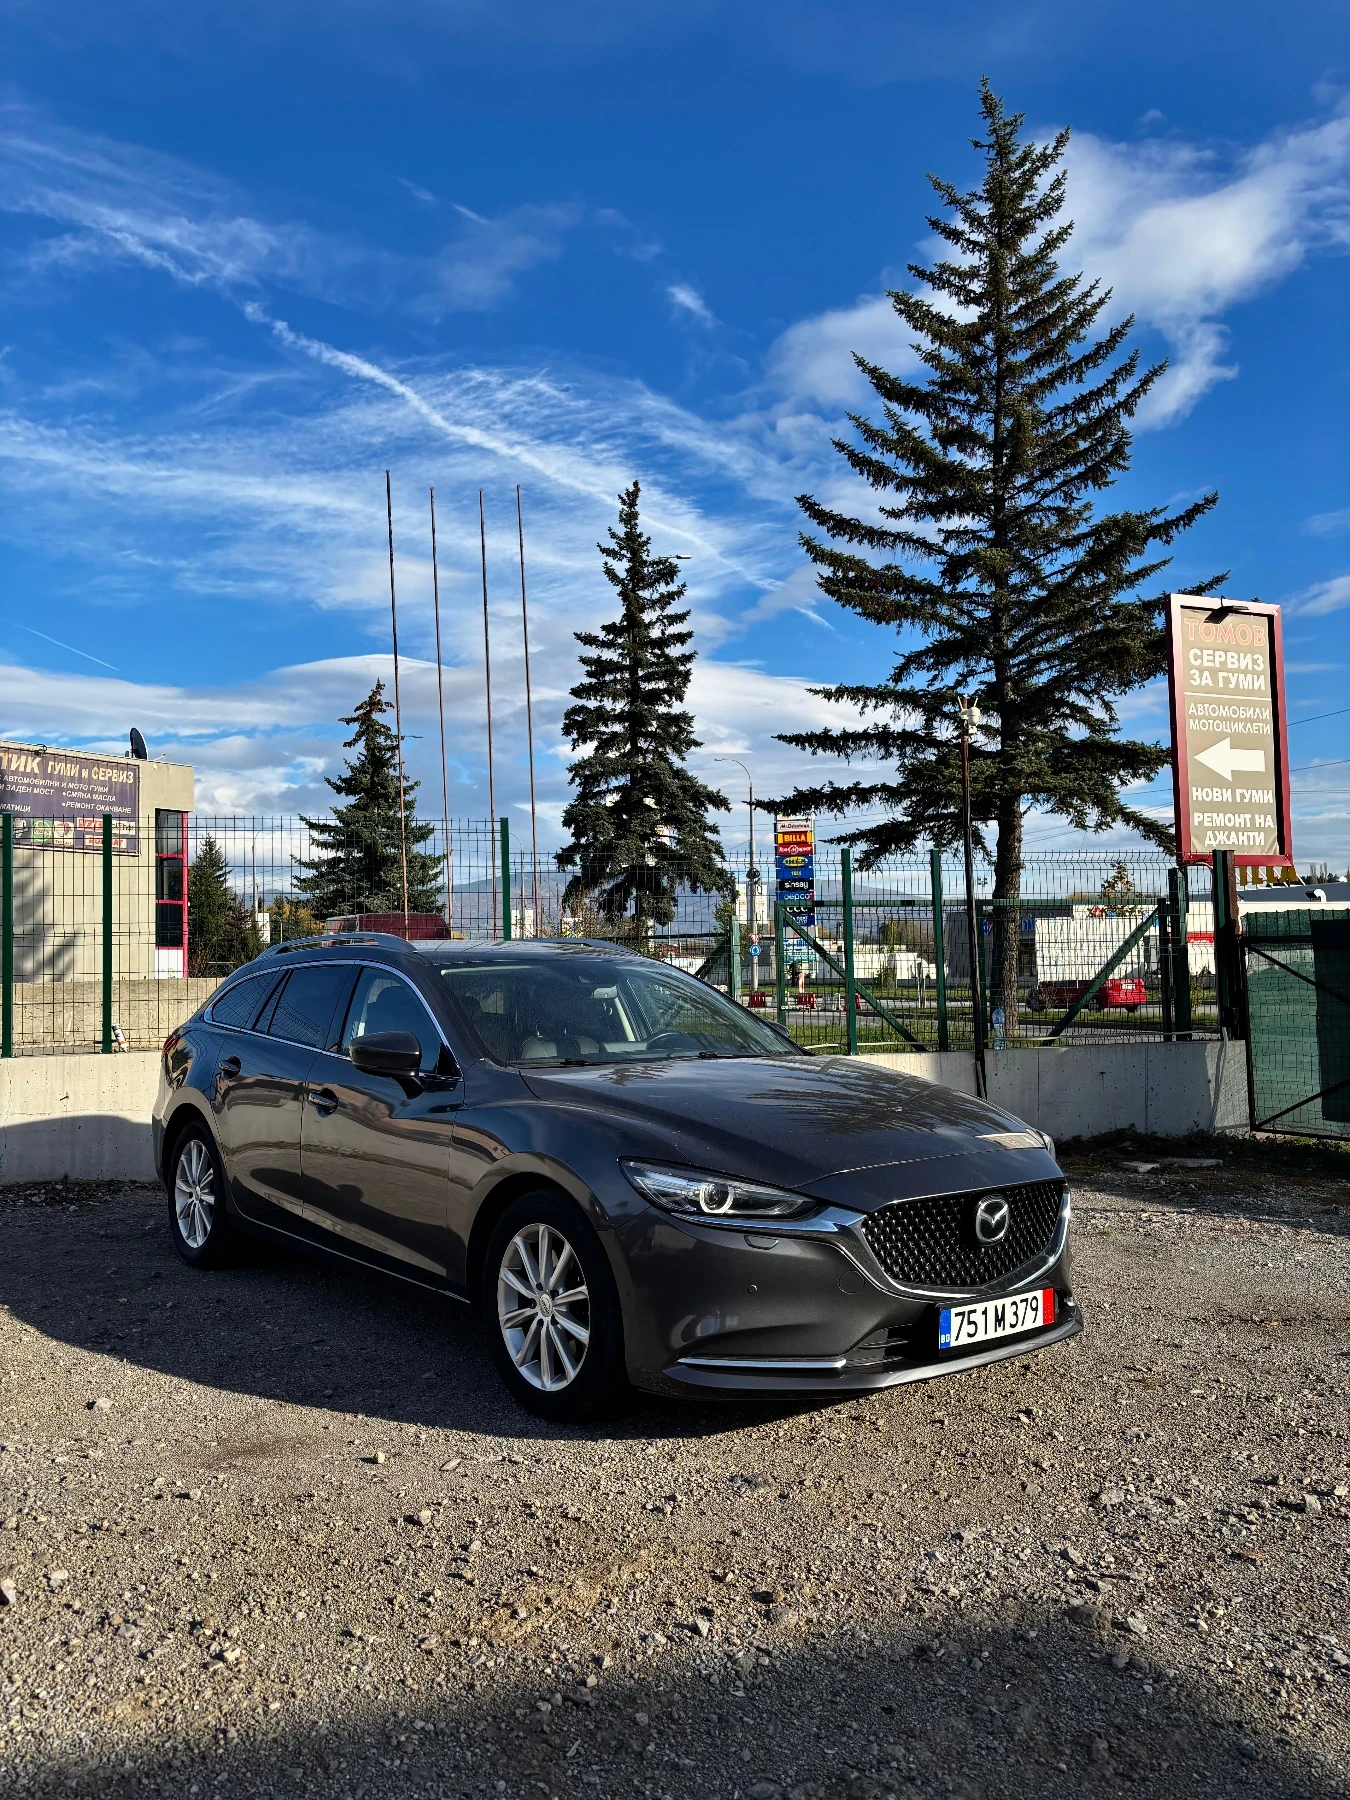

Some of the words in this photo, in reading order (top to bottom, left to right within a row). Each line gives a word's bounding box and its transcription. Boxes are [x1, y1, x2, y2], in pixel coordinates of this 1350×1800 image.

[1184, 618, 1265, 647] ТОМОВ
[1189, 648, 1265, 671] СЕРВИЗ
[1189, 669, 1213, 687] ЗА
[1218, 672, 1266, 690] ГУМИ
[1188, 703, 1270, 720] АВТОМОБИЛИ
[1189, 719, 1271, 735] МОТОЦИКЛЕТИ
[48, 761, 79, 777] ГУМИ
[92, 766, 133, 784] СЕРВИЗ
[3, 774, 60, 788] АВТОМОБИЛНИ
[68, 782, 88, 791] МОТО
[90, 784, 108, 793] ГУМИ
[6, 784, 32, 794] ЗАДЕН
[33, 787, 54, 796] МОСТ
[66, 790, 91, 799] СМЯНА
[93, 793, 116, 802] МАСЛА
[1192, 787, 1233, 802] НОВИ
[1236, 788, 1273, 804] ГУМИ
[66, 801, 95, 810] РЕМОНТ
[96, 804, 132, 814] ОКАЧВАНЕ
[1194, 812, 1252, 828] РЕМОНТ
[1255, 814, 1274, 828] НА
[784, 834, 806, 842] BILLA
[1205, 831, 1264, 847] ДЖАНТИ
[785, 880, 809, 890] sinsay
[954, 1295, 1039, 1341] 751M379
[941, 1334, 950, 1343] BG
